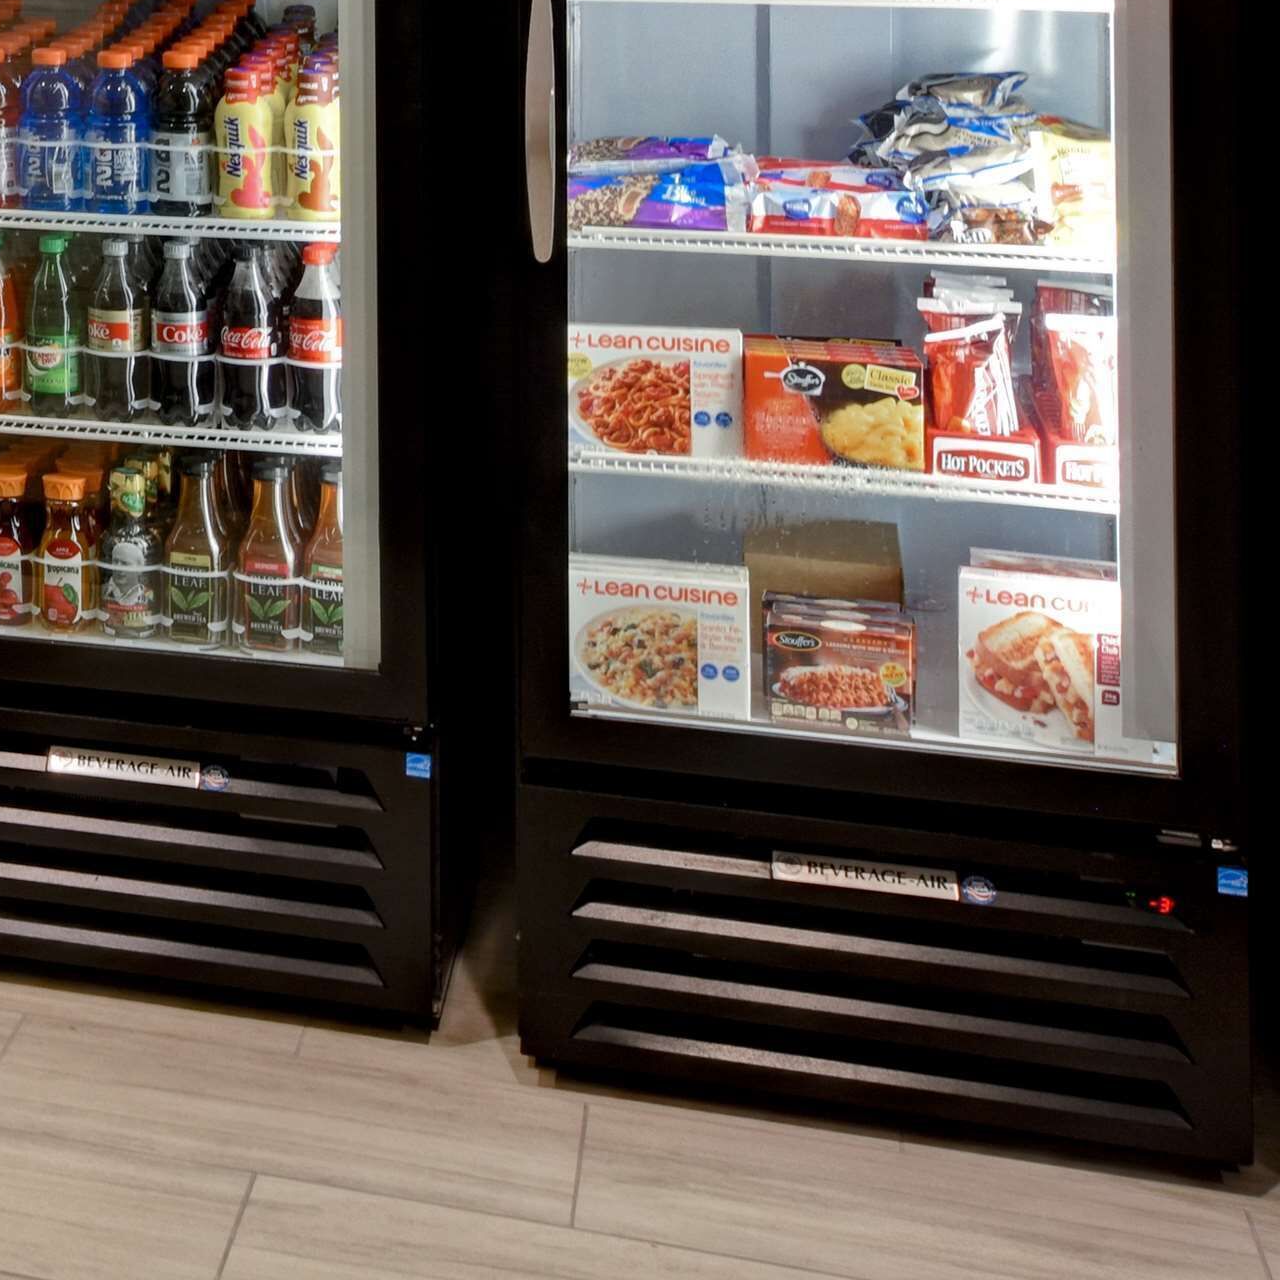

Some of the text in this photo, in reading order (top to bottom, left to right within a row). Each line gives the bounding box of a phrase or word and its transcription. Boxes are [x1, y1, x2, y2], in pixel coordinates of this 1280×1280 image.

[88, 323, 111, 339] oke
[162, 324, 204, 343] Coke
[588, 332, 731, 354] Lean cuisine
[869, 368, 911, 386] Classic
[940, 453, 1025, 477] HOT POCKETS
[594, 580, 739, 607] Lean cuisine
[985, 588, 1046, 610] Lean
[76, 753, 192, 781] BEVERAGE AIR
